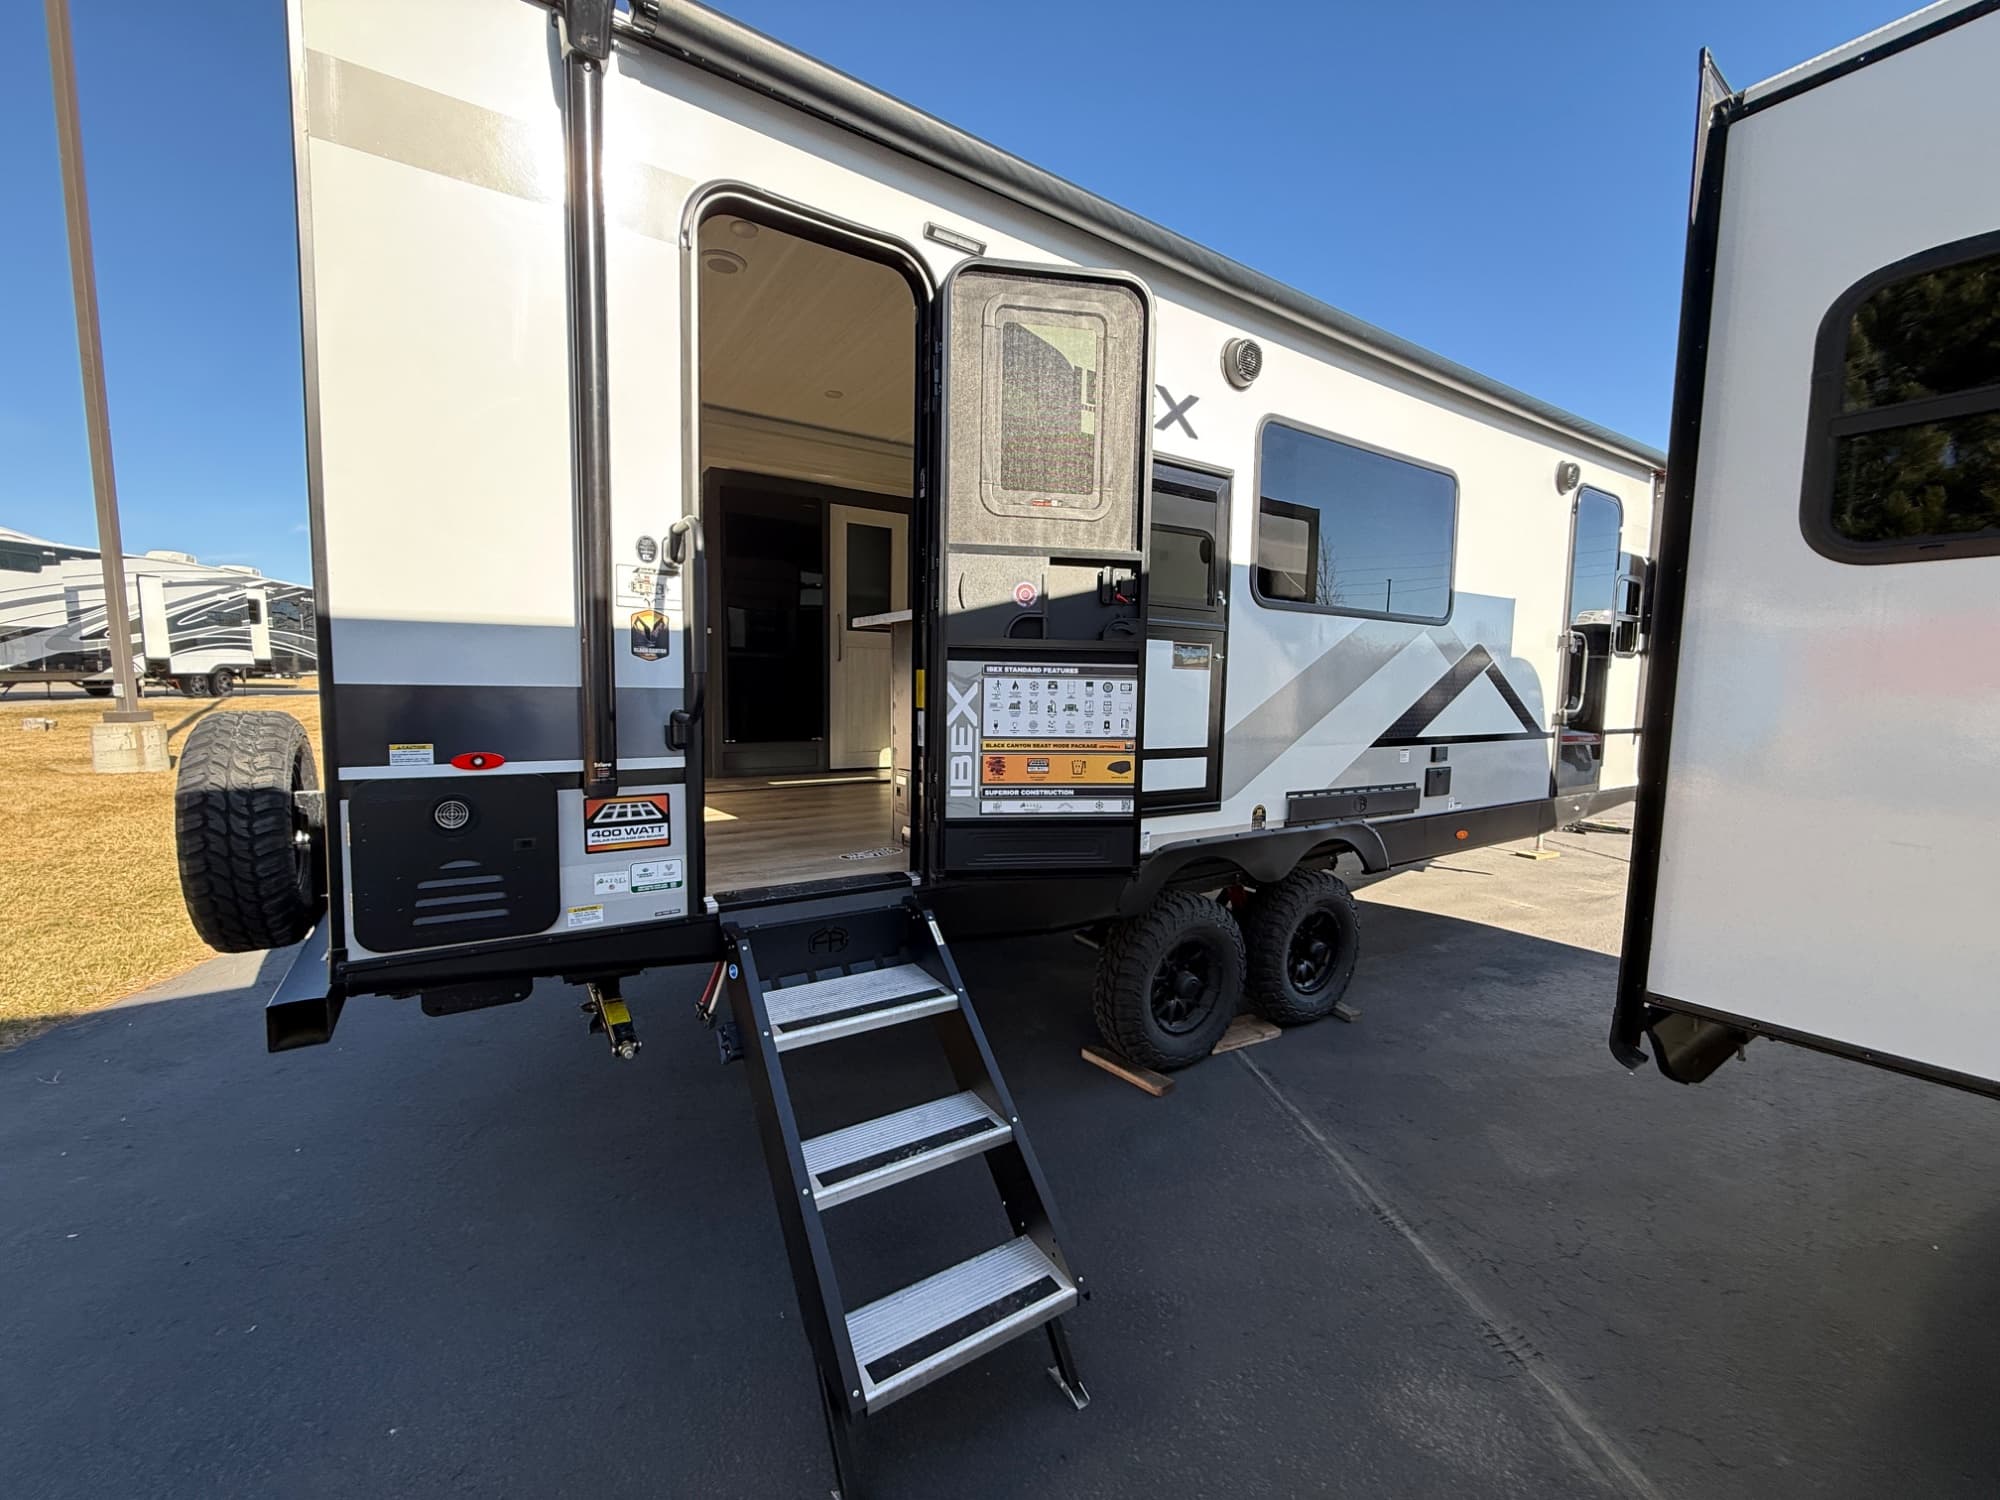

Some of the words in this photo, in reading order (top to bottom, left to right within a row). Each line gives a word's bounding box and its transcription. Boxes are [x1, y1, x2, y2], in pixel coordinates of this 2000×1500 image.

[1153, 383, 1200, 440] X
[986, 665, 1003, 673] IBEX
[1004, 666, 1042, 674] STANDARD
[947, 681, 978, 797] IBEX
[591, 828, 622, 838] 400
[624, 825, 664, 836] WATT
